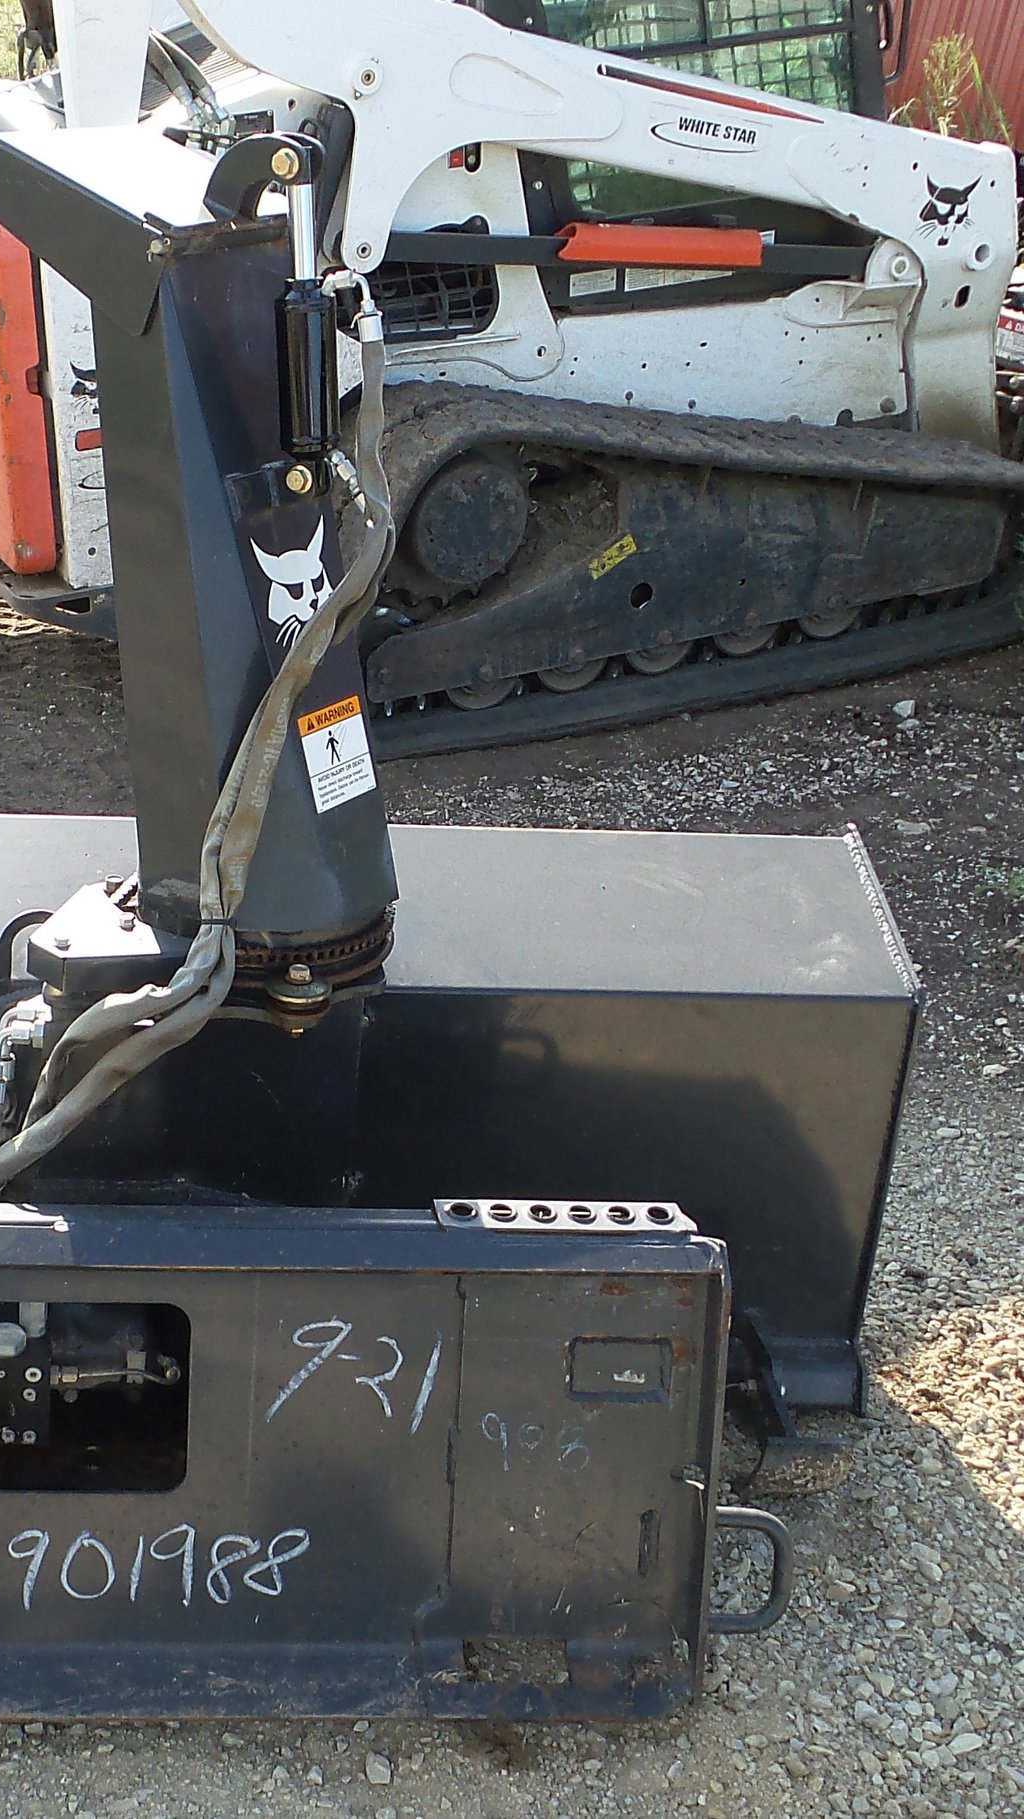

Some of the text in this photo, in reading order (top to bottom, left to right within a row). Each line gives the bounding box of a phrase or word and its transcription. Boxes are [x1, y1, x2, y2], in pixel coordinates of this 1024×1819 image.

[678, 117, 756, 144] WHITE STAR
[315, 702, 354, 725] WARNING
[266, 1316, 442, 1435] 9-21
